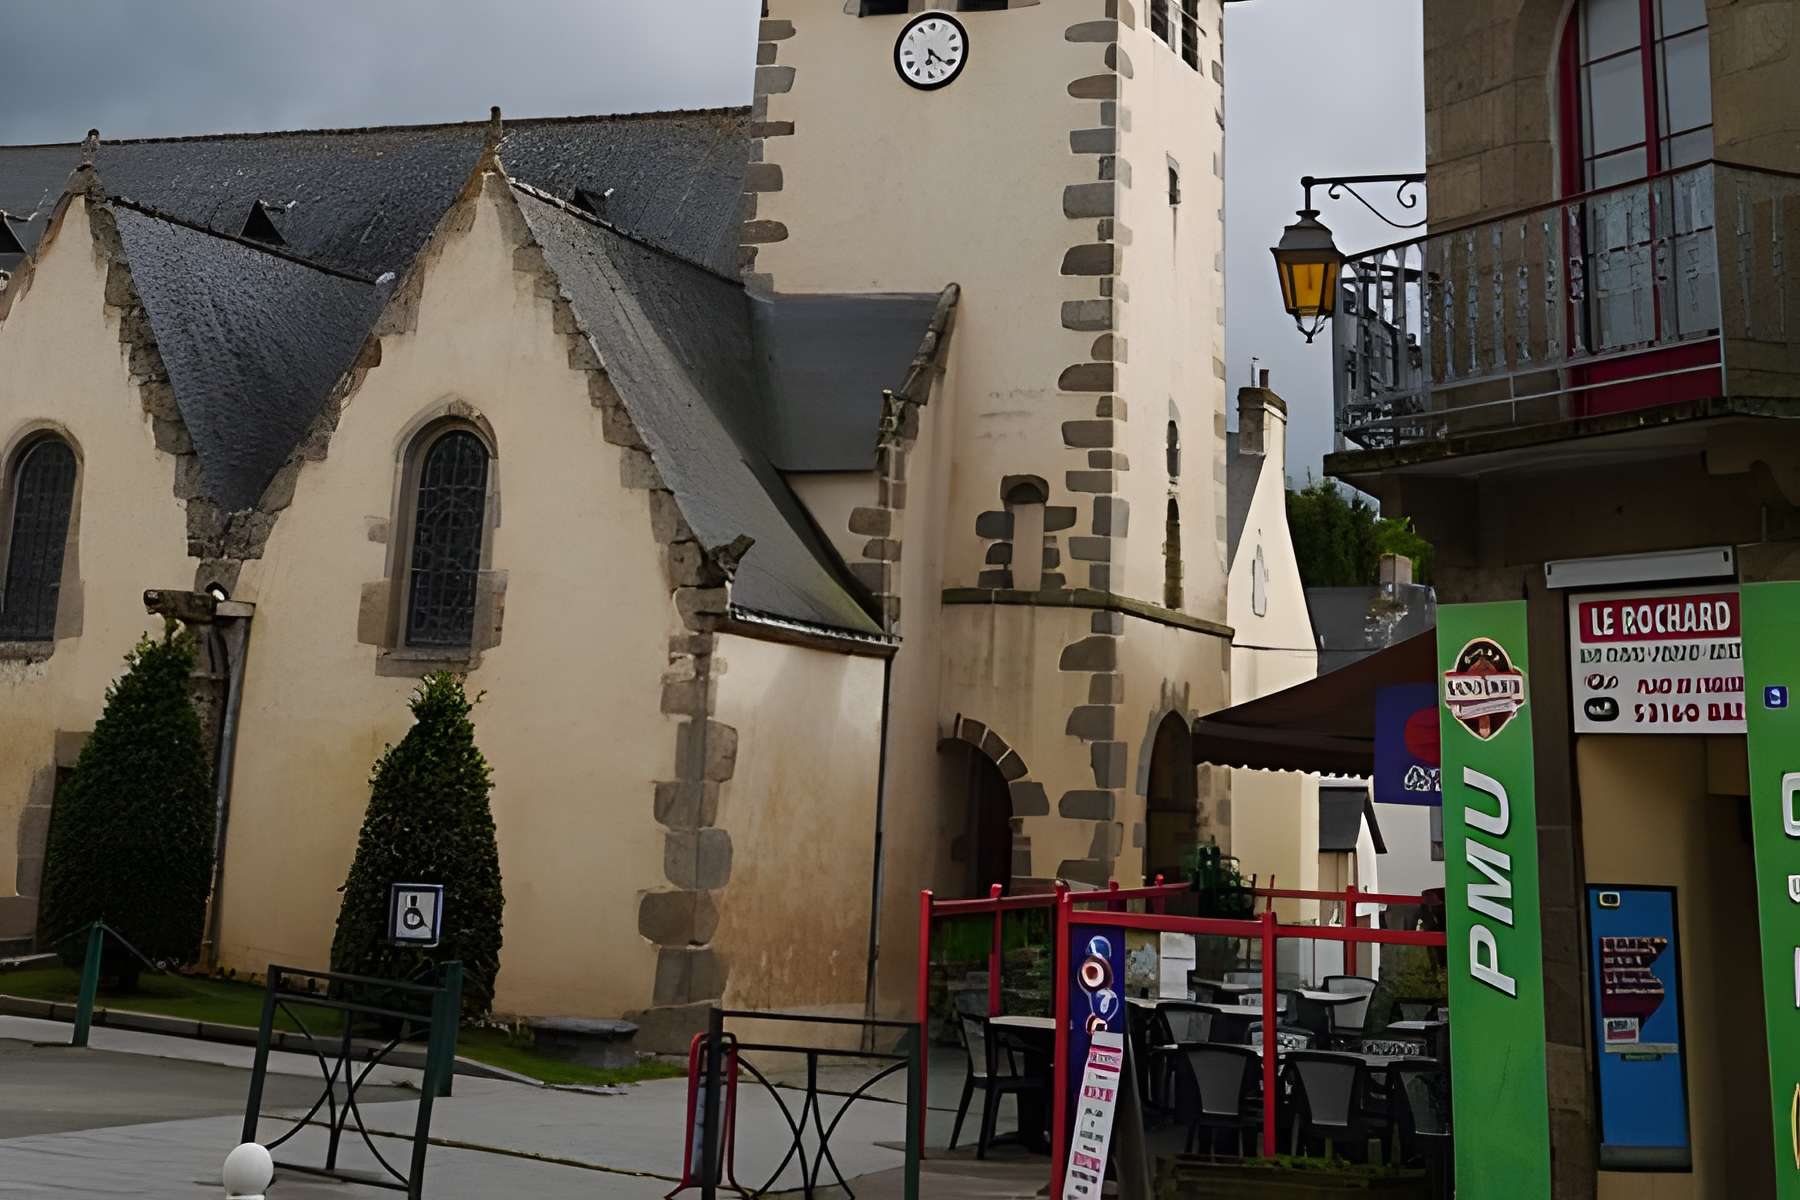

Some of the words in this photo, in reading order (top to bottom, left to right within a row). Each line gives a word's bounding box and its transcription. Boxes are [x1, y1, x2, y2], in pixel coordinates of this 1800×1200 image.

[1591, 606, 1615, 636] LE
[1621, 600, 1731, 636] ROCHARD
[1463, 766, 1516, 996] PMU
